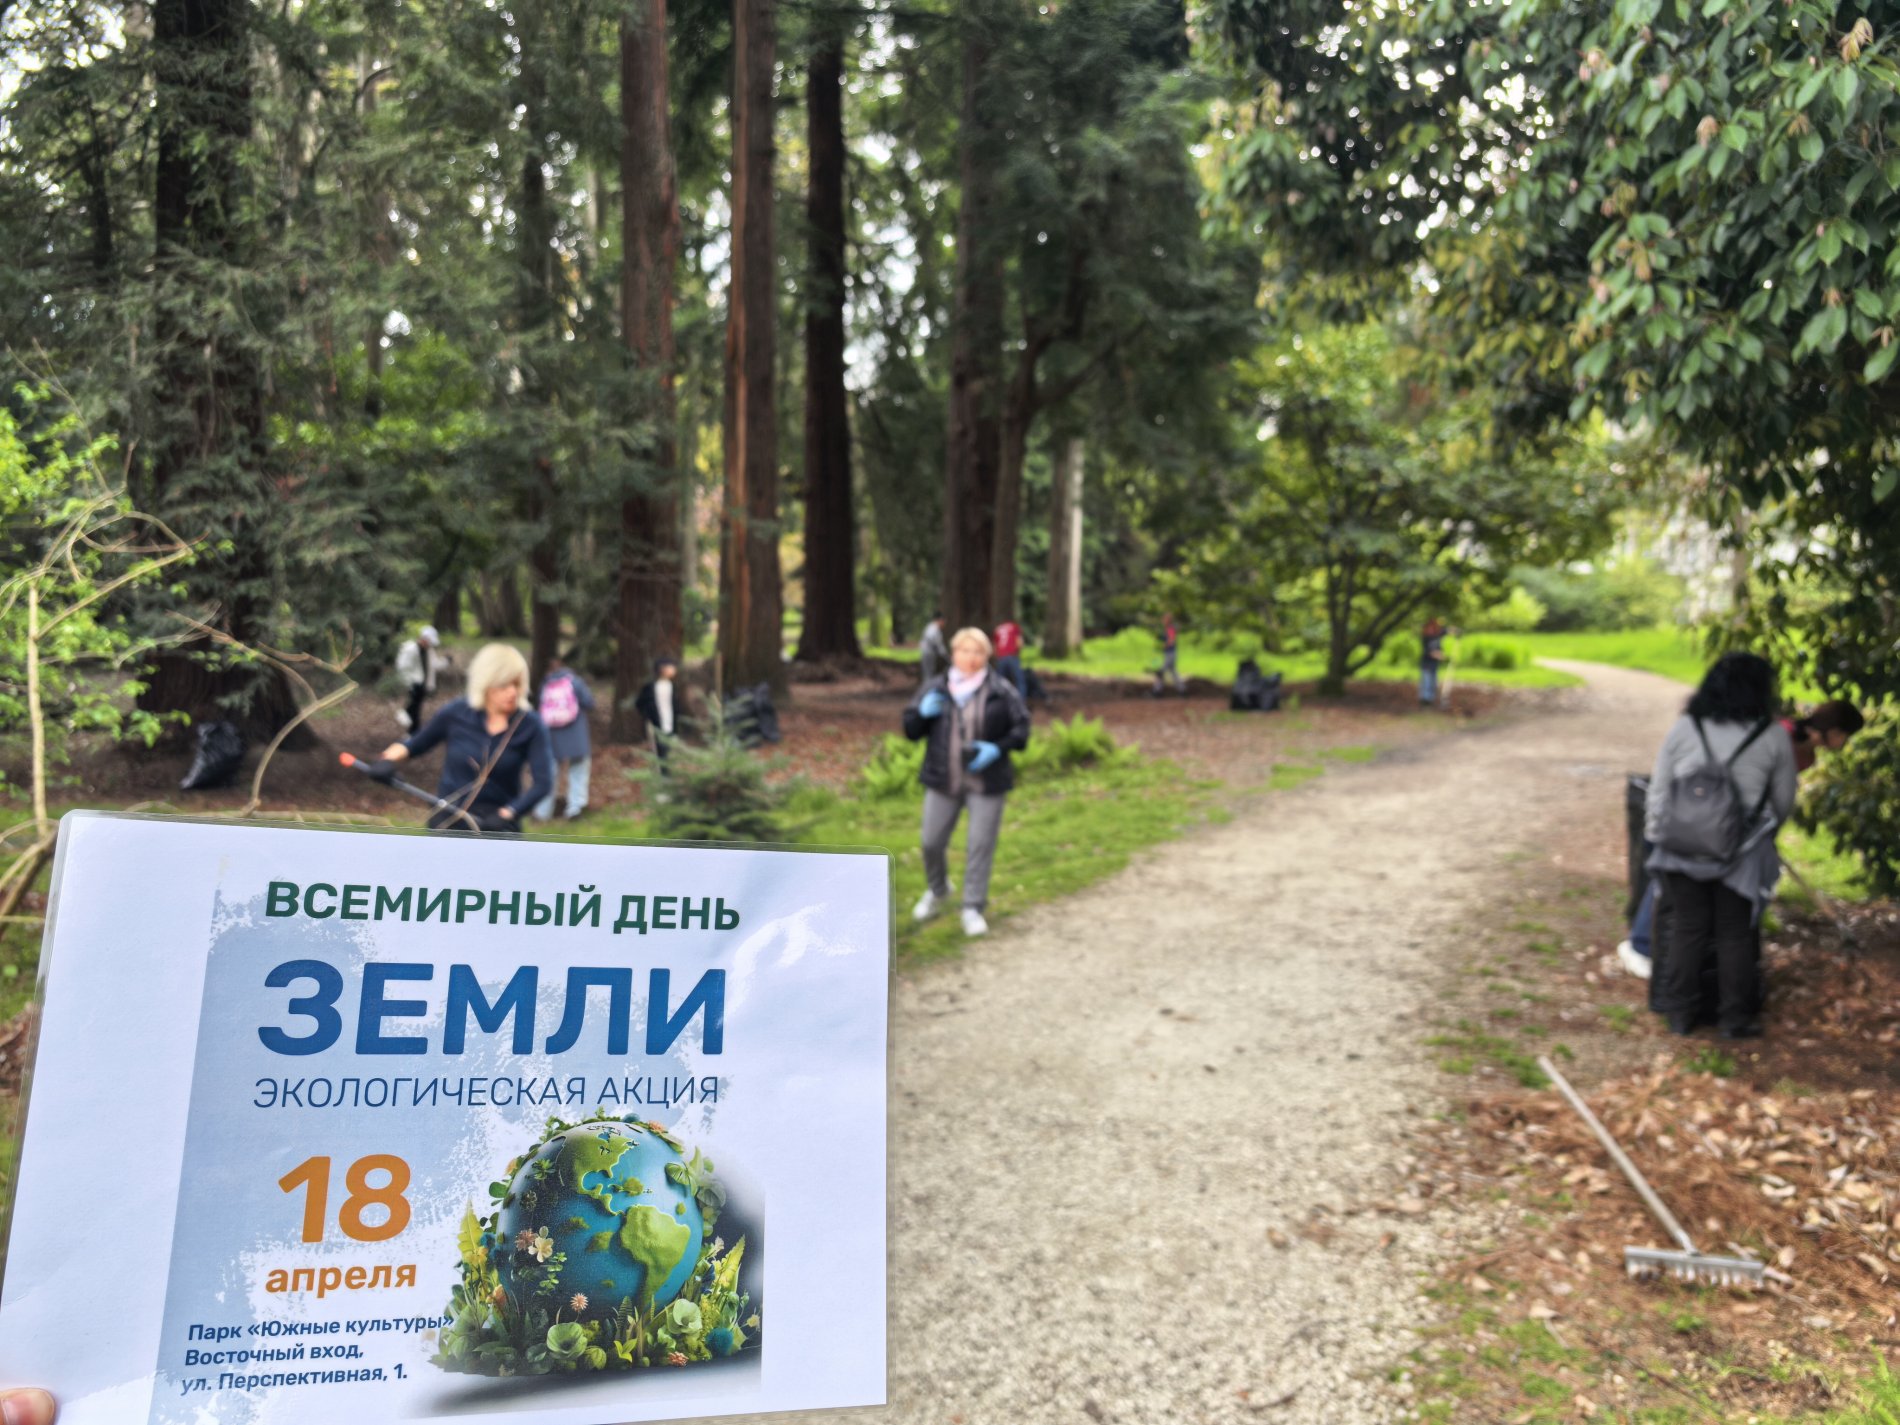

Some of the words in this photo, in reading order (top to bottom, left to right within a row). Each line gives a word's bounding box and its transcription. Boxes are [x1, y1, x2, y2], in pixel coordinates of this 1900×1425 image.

[265, 881, 601, 928] ВСЕМИРНЫЙ
[613, 895, 740, 934] ДЕНЬ
[257, 959, 726, 1056] ЗЕМЛИ
[253, 1077, 585, 1108] ЭКОЛОГИЧЕСКАЯ
[597, 1077, 719, 1110] АКЦИЯ
[278, 1153, 411, 1243] 18
[265, 1264, 417, 1299] апреля
[188, 1324, 242, 1343] Парк
[247, 1319, 341, 1337] «Южные
[345, 1315, 454, 1336] культуры»
[185, 1343, 304, 1366] Восточный
[310, 1345, 364, 1360] вход,
[180, 1377, 211, 1395] ул.
[218, 1367, 388, 1391] Перспективная,
[394, 1363, 408, 1379] 1.
